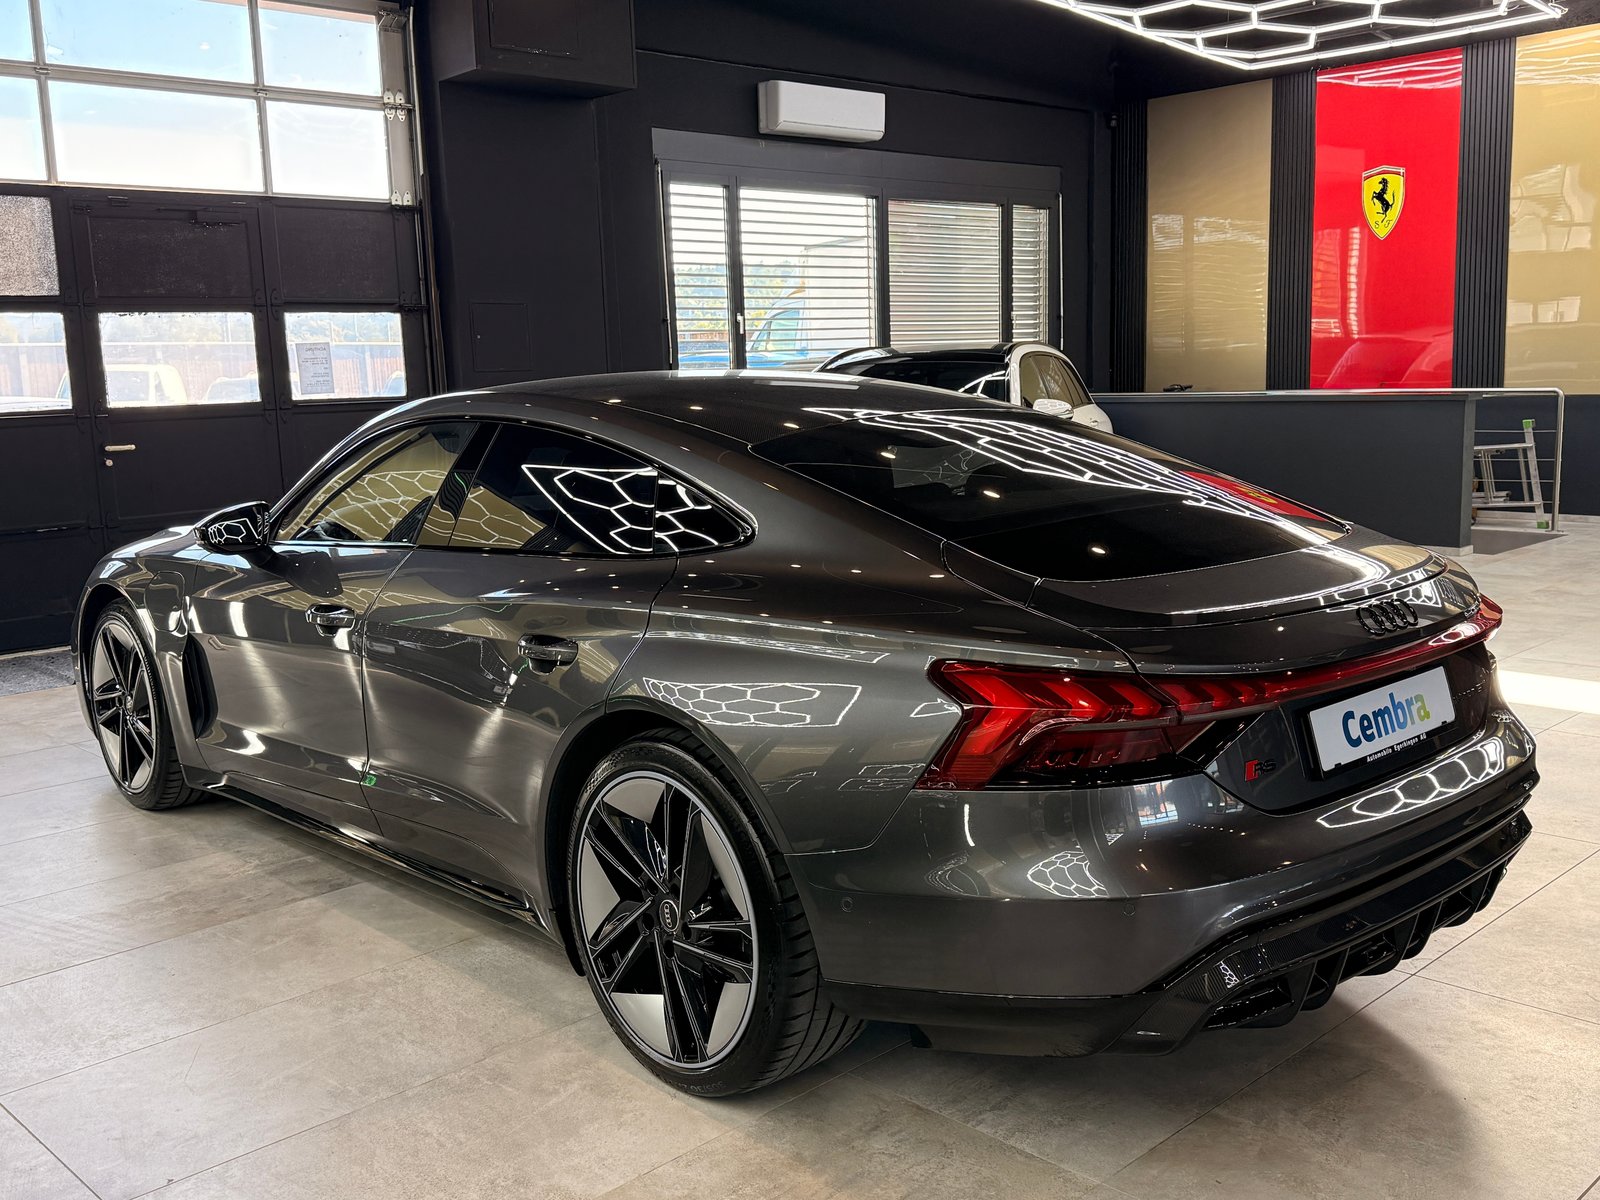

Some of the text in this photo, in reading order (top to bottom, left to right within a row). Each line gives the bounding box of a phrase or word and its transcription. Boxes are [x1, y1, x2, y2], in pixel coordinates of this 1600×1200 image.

[1374, 220, 1380, 229] S
[1342, 692, 1430, 748] Cembra
[1366, 732, 1427, 763] Automobile Egerkingen AG
[1247, 759, 1276, 780] RS
